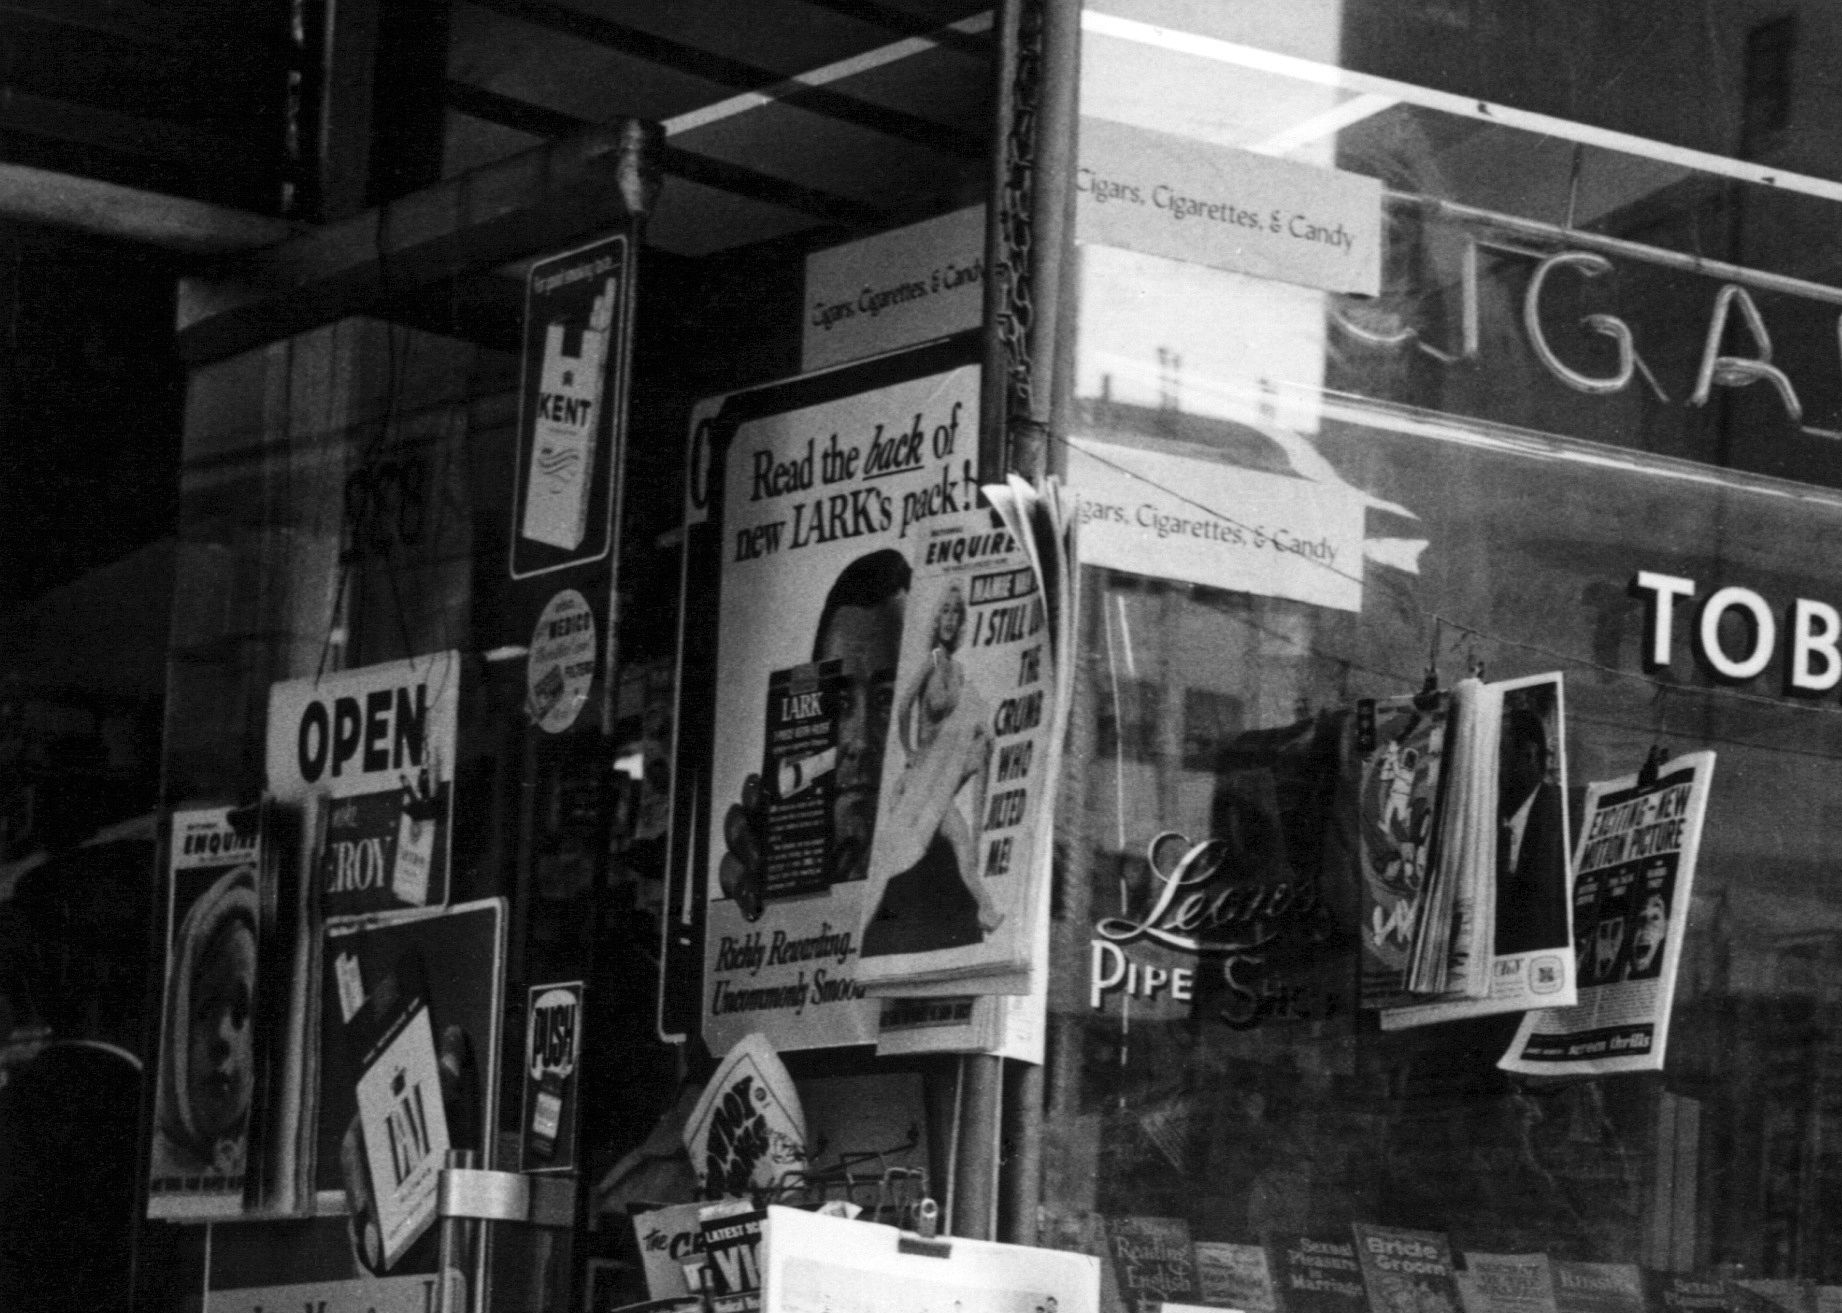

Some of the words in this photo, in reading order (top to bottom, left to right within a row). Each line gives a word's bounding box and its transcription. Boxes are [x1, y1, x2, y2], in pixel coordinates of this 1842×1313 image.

[1076, 168, 1145, 205] Cigars,
[1152, 185, 1265, 231] Cigarettes,
[1289, 214, 1355, 251] Candy
[538, 393, 592, 428] KENT
[751, 439, 815, 502] Read
[822, 433, 860, 484] the
[864, 414, 925, 480] back
[933, 402, 963, 460] of
[735, 520, 787, 562] new
[790, 487, 892, 550] LARK's
[902, 459, 973, 538] pack!
[1136, 504, 1247, 548] Cigarettes,
[1272, 529, 1339, 561] Candy
[298, 683, 428, 784] OPEN
[782, 692, 823, 722] LARK
[715, 935, 766, 976] Richly
[1090, 937, 1194, 1009] PIPE
